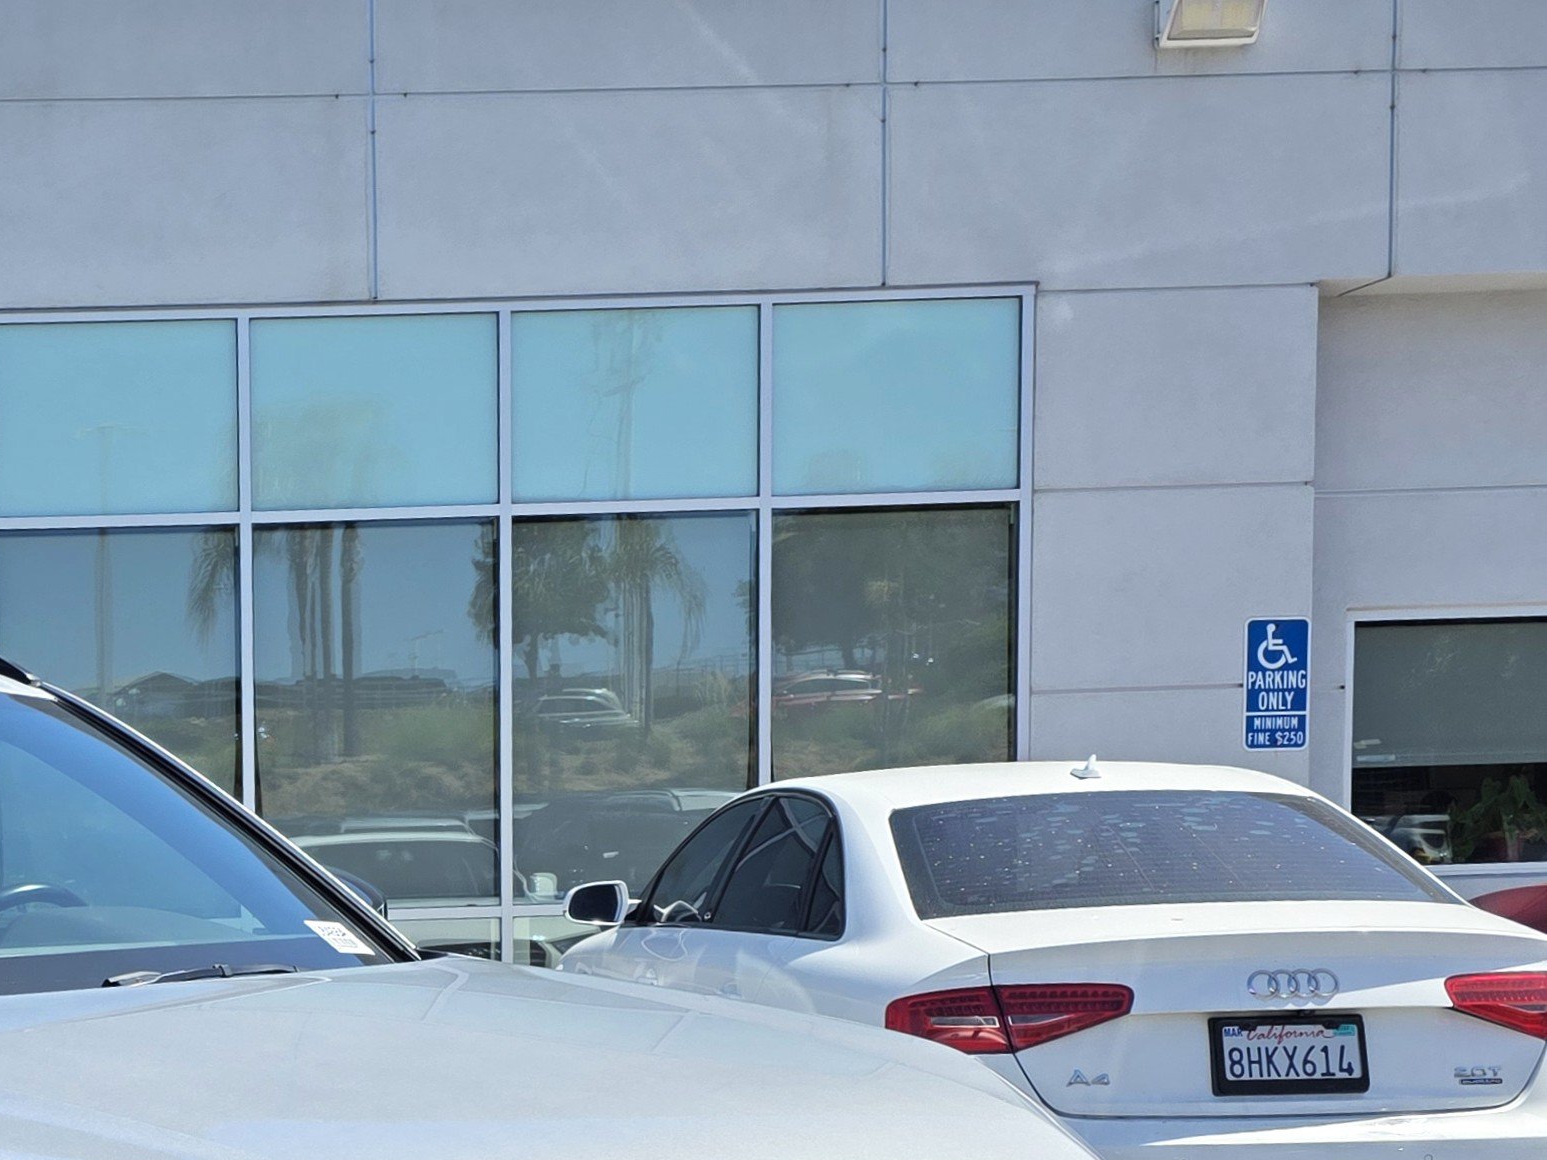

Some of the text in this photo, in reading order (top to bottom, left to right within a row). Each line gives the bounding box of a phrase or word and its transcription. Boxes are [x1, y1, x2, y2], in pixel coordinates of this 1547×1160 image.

[1248, 670, 1306, 690] PARKING
[1258, 692, 1294, 710] ONLY
[1254, 717, 1298, 730] MINIMUM
[1248, 731, 1303, 746] FINE $250
[1246, 1024, 1334, 1044] California
[1228, 1044, 1354, 1078] 8HKX614
[1066, 1068, 1110, 1087] A4
